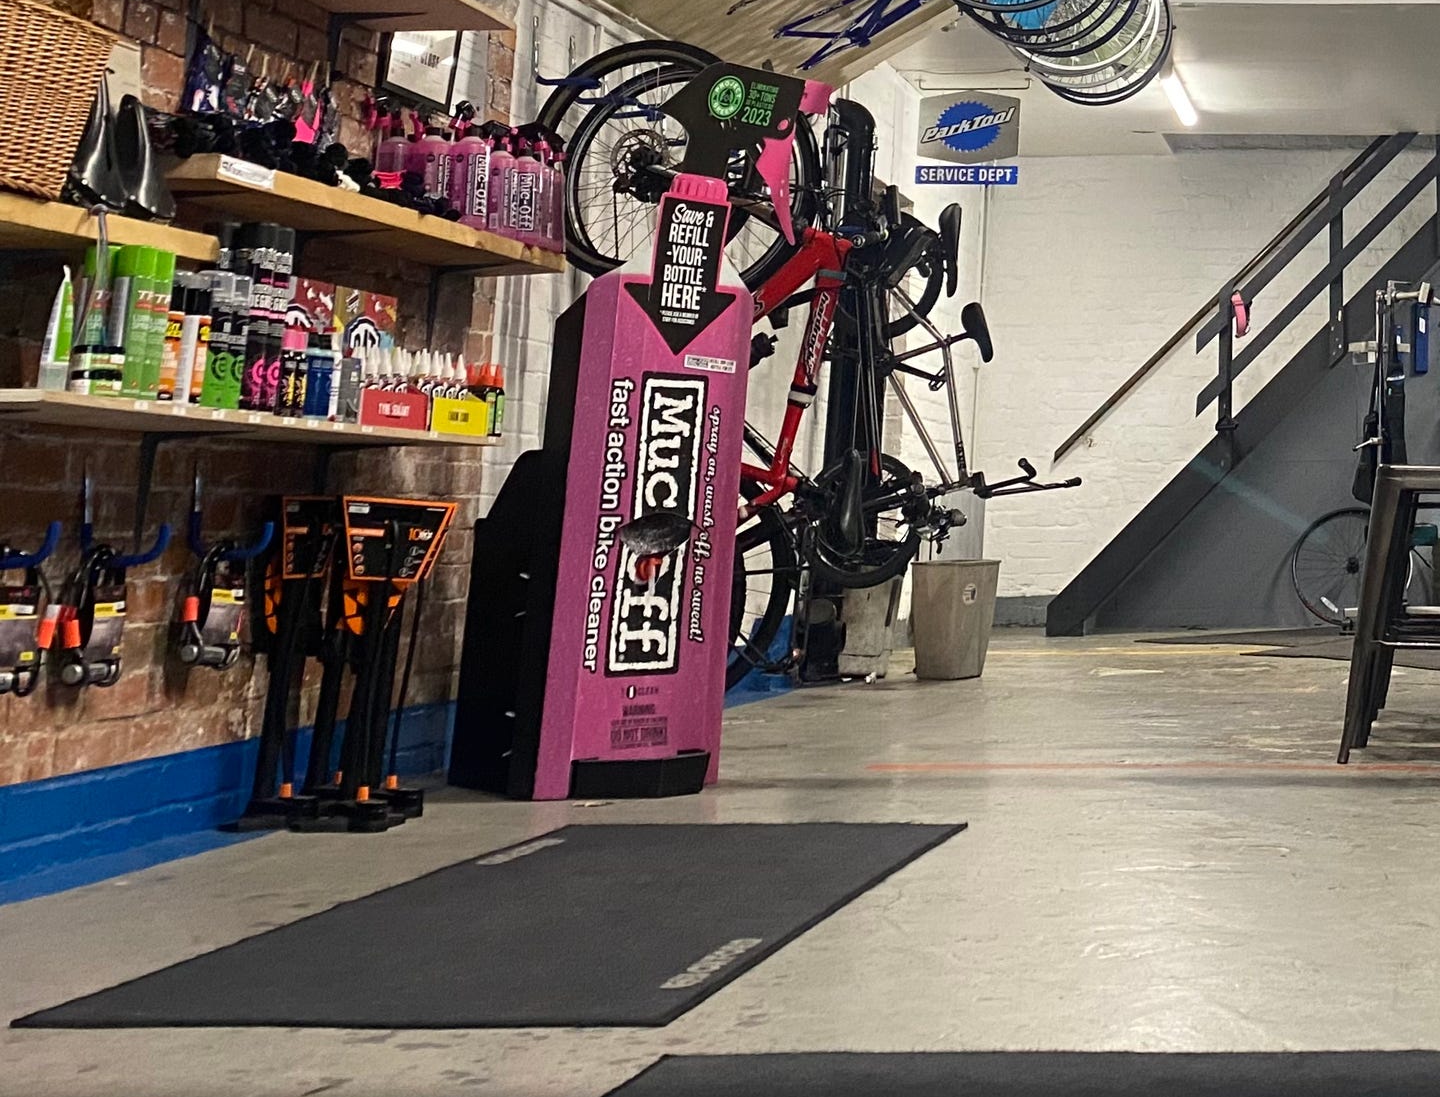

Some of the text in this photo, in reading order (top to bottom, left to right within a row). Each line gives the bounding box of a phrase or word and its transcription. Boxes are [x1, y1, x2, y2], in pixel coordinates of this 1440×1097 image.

[741, 106, 772, 126] 2023
[920, 168, 1013, 182] SERVICE DEPT
[520, 174, 534, 230] Muc-Off
[672, 203, 715, 228] Save &
[668, 223, 710, 247] REFILL
[663, 264, 705, 286] BOTTLE
[706, 406, 721, 454] spray
[584, 379, 634, 672] fast action bike cleaner
